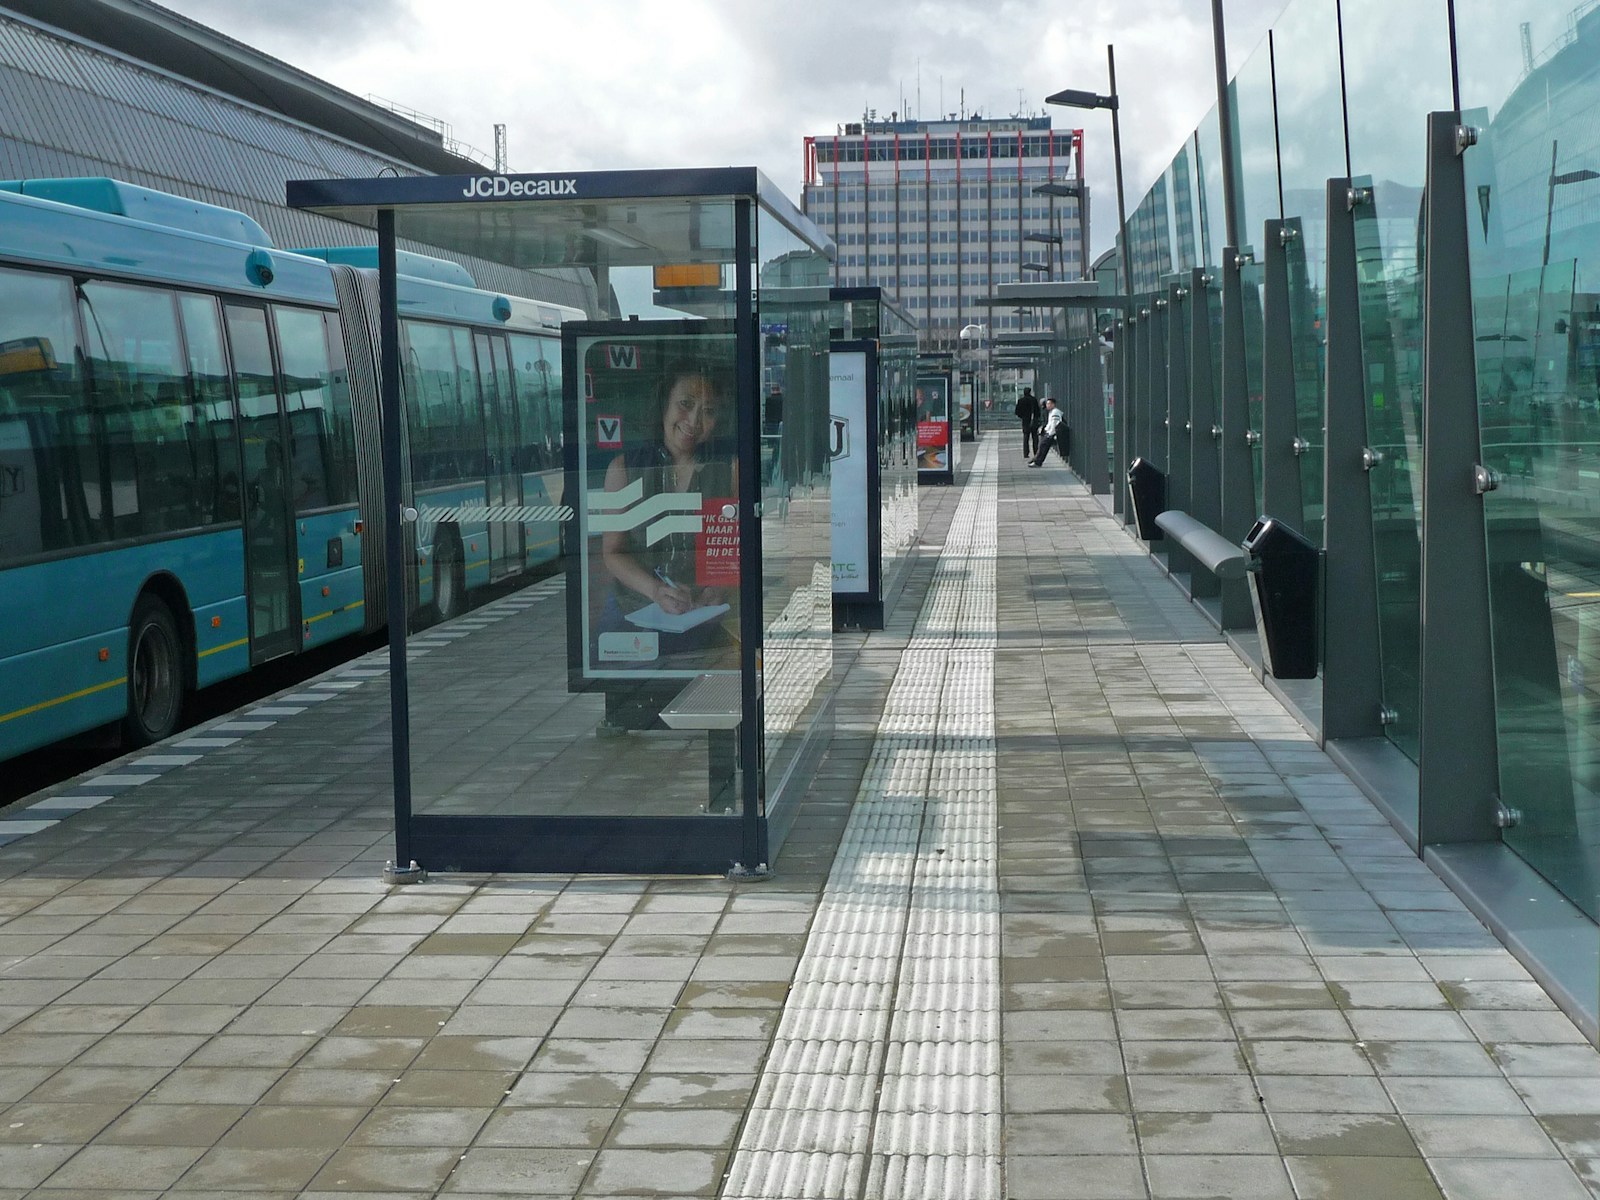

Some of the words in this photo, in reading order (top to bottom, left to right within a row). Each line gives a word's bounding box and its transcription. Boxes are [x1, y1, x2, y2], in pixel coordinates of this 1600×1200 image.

[463, 176, 577, 197] JCDecaux
[610, 346, 635, 367] W
[830, 373, 854, 381] emaal
[600, 419, 619, 440] V
[706, 525, 723, 534] MAAR
[706, 548, 717, 557] BIJ
[721, 548, 734, 557] DE
